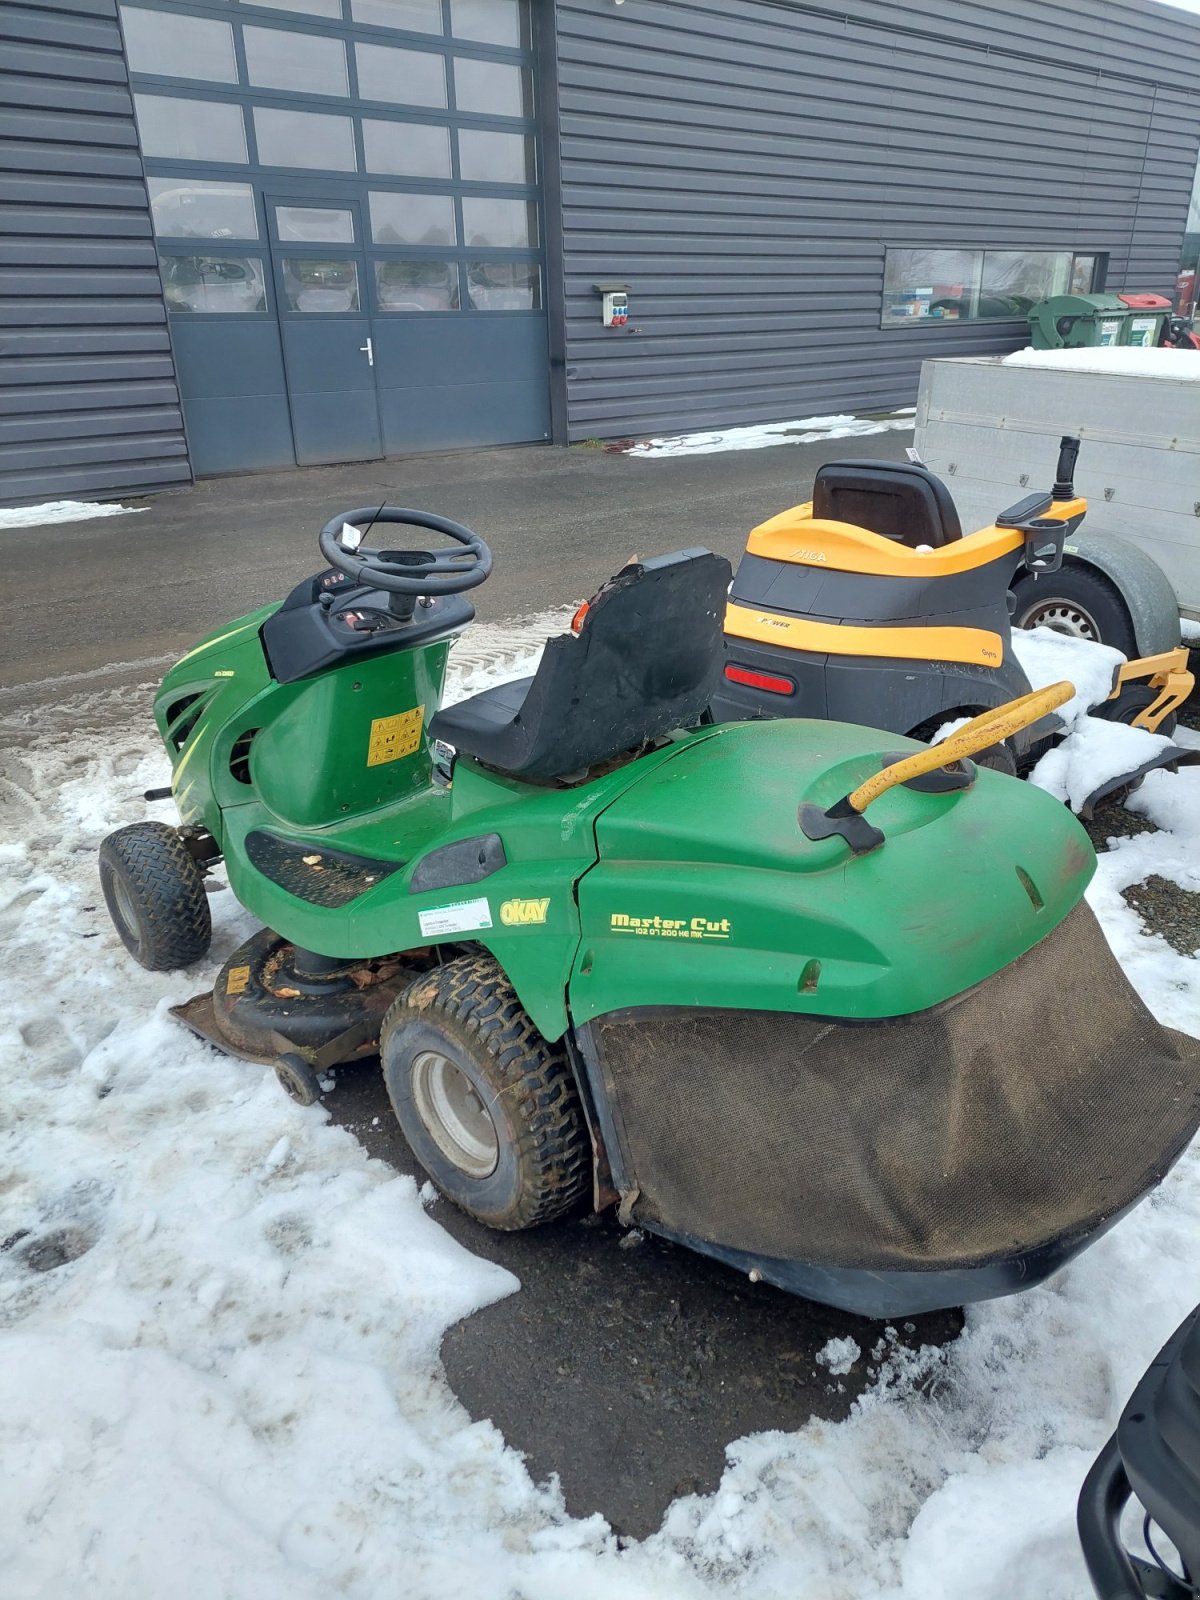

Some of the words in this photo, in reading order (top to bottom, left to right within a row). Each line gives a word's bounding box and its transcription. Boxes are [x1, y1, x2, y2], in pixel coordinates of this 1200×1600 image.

[981, 648, 997, 659] Gyro
[500, 898, 550, 925] OKAY
[611, 913, 687, 930] Master
[690, 917, 731, 932] Cut
[635, 927, 649, 936] 102
[661, 929, 678, 937] 200
